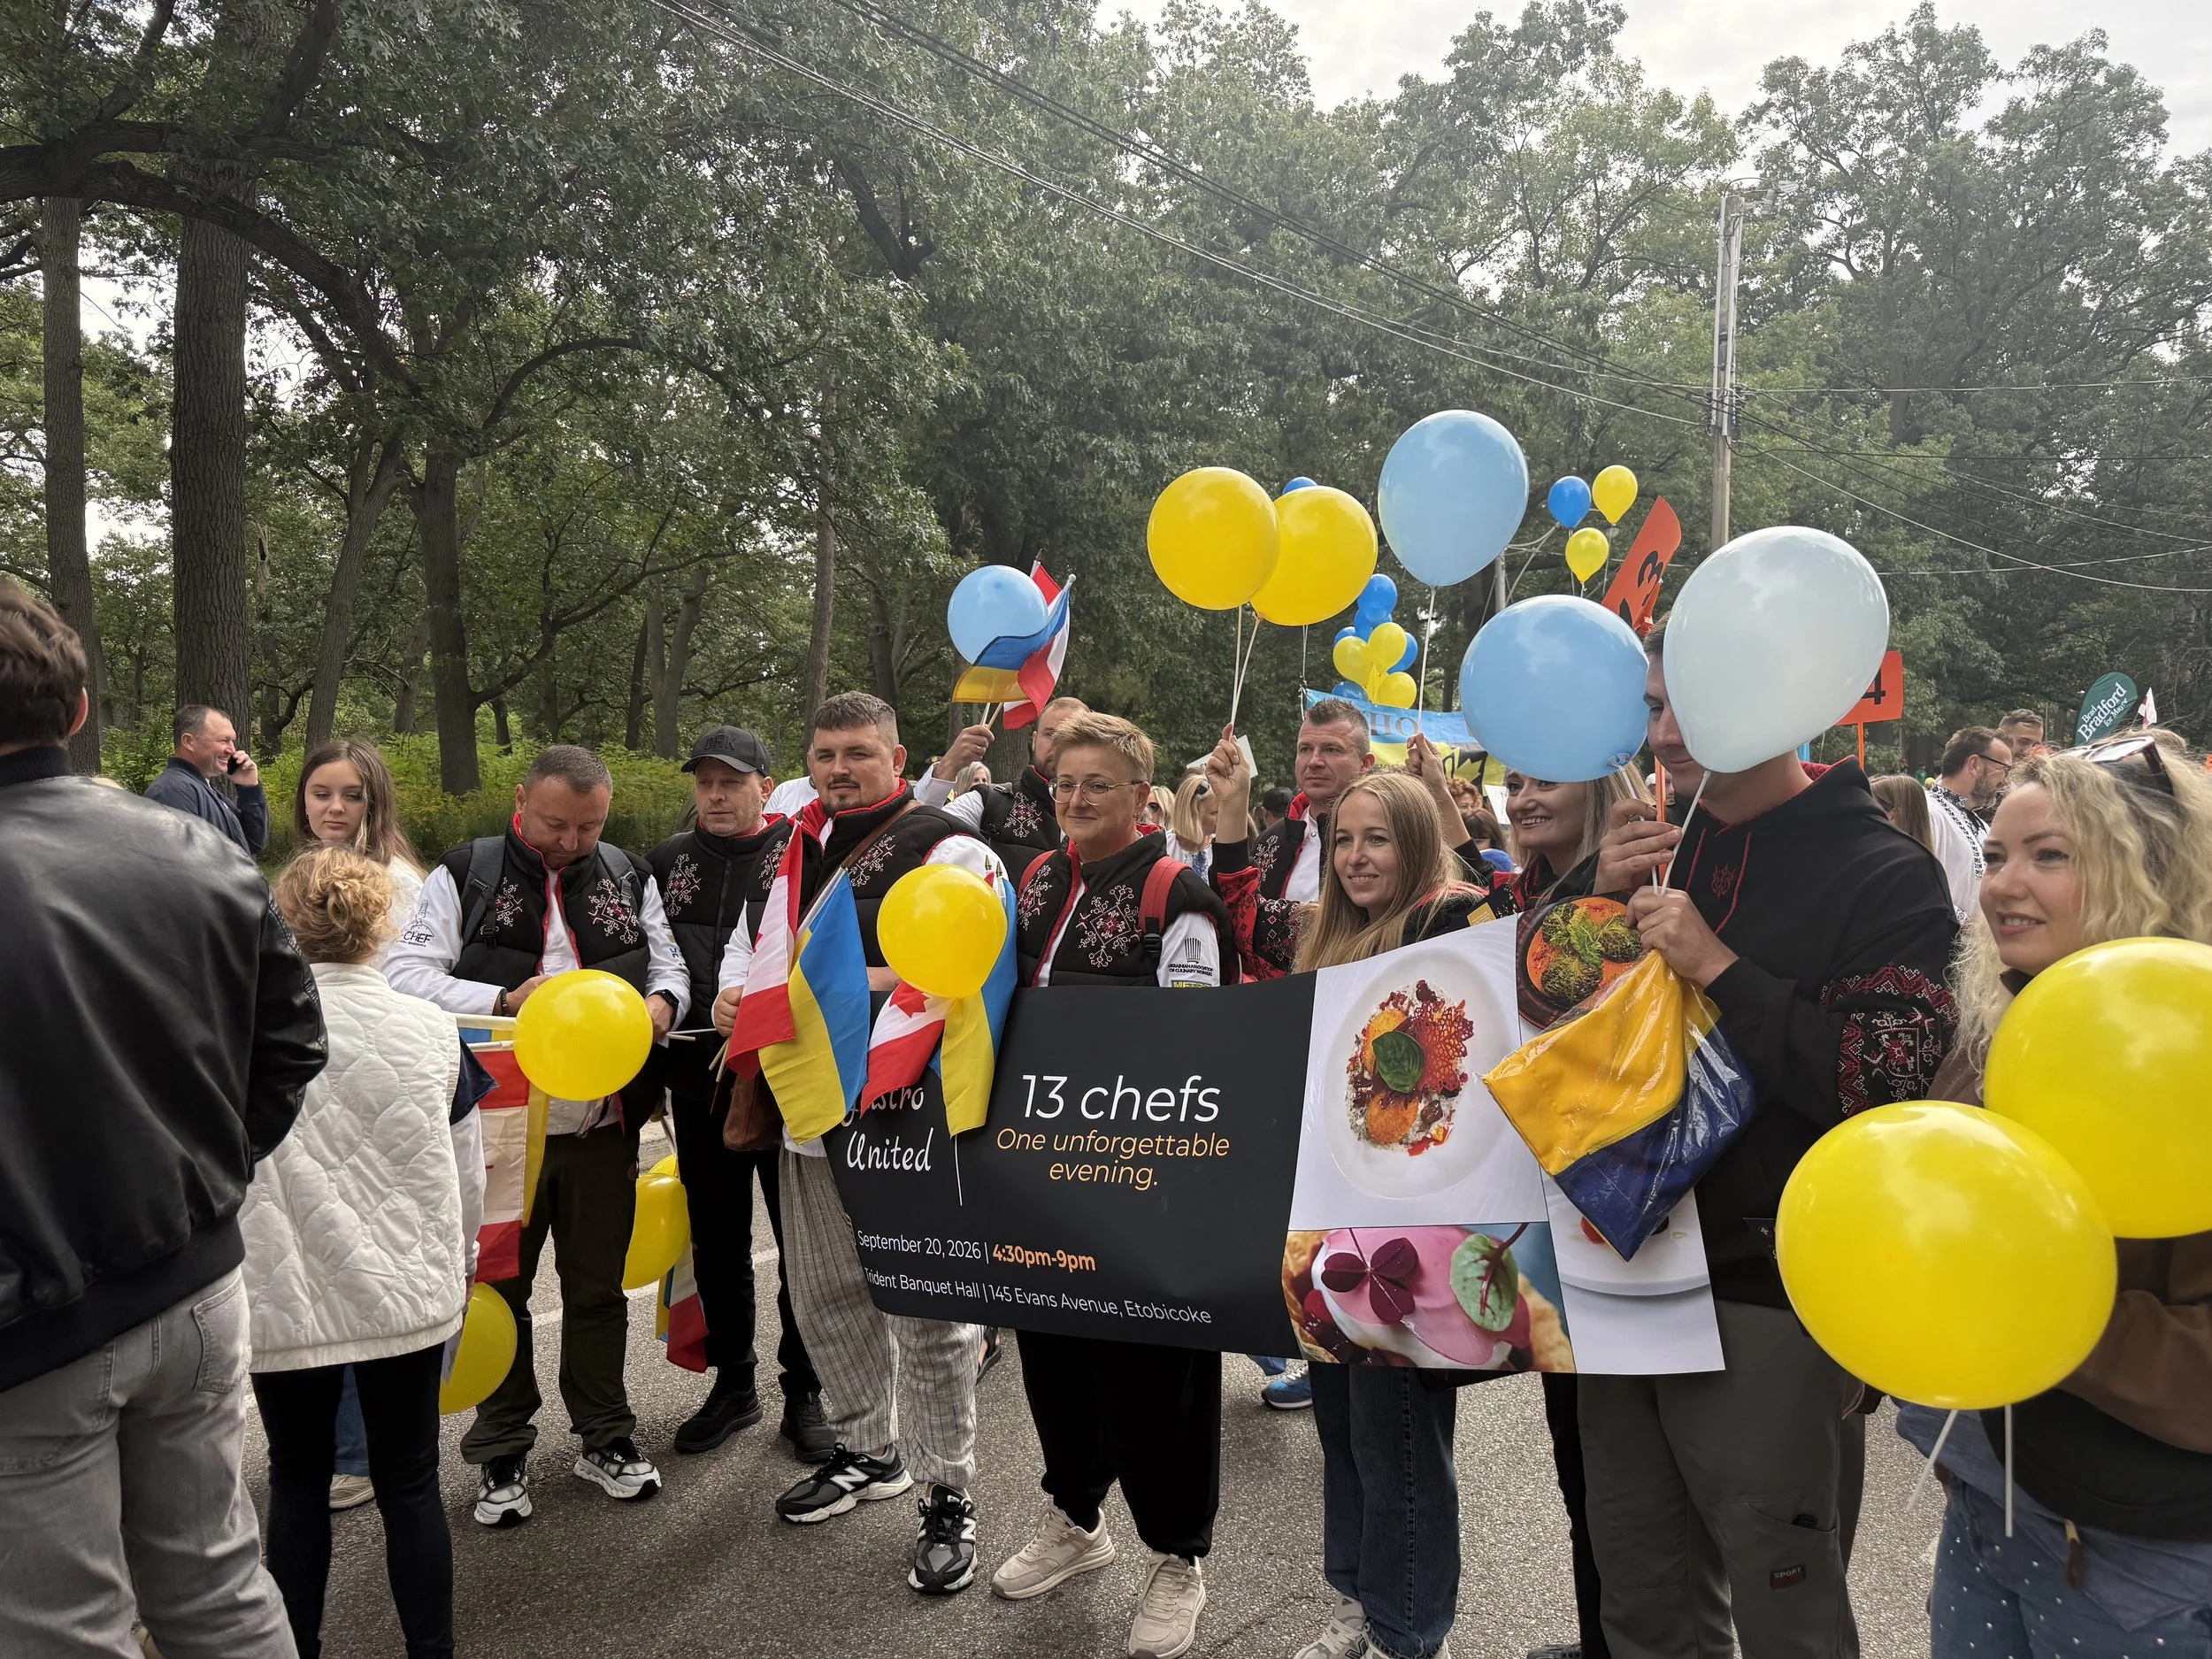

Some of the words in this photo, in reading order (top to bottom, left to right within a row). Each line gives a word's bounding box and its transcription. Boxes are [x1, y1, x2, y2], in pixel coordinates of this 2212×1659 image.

[2077, 681, 2127, 741] Bradford
[2082, 704, 2098, 724] Brad
[2103, 716, 2114, 727] for
[2110, 697, 2128, 718] Mayor
[1022, 1074, 1068, 1118] 13
[1080, 1074, 1221, 1122] chefs
[847, 1126, 934, 1172] United
[996, 1128, 1046, 1151] One
[1053, 1129, 1230, 1160] unforgettable
[1049, 1159, 1158, 1191] evening.
[857, 1230, 921, 1252] September
[924, 1238, 946, 1259] 20,
[947, 1240, 981, 1259] 2026
[992, 1243, 1096, 1273] 4:30pm-9pm
[864, 1266, 897, 1288] Trident
[900, 1274, 953, 1296] Banquet
[955, 1281, 980, 1299] Hall
[988, 1285, 1012, 1302] 145
[1014, 1287, 1057, 1308] Evans
[1061, 1293, 1123, 1317] Avenue,
[1124, 1300, 1212, 1324] Etobicoke
[1773, 1567, 1801, 1578] SPORT
